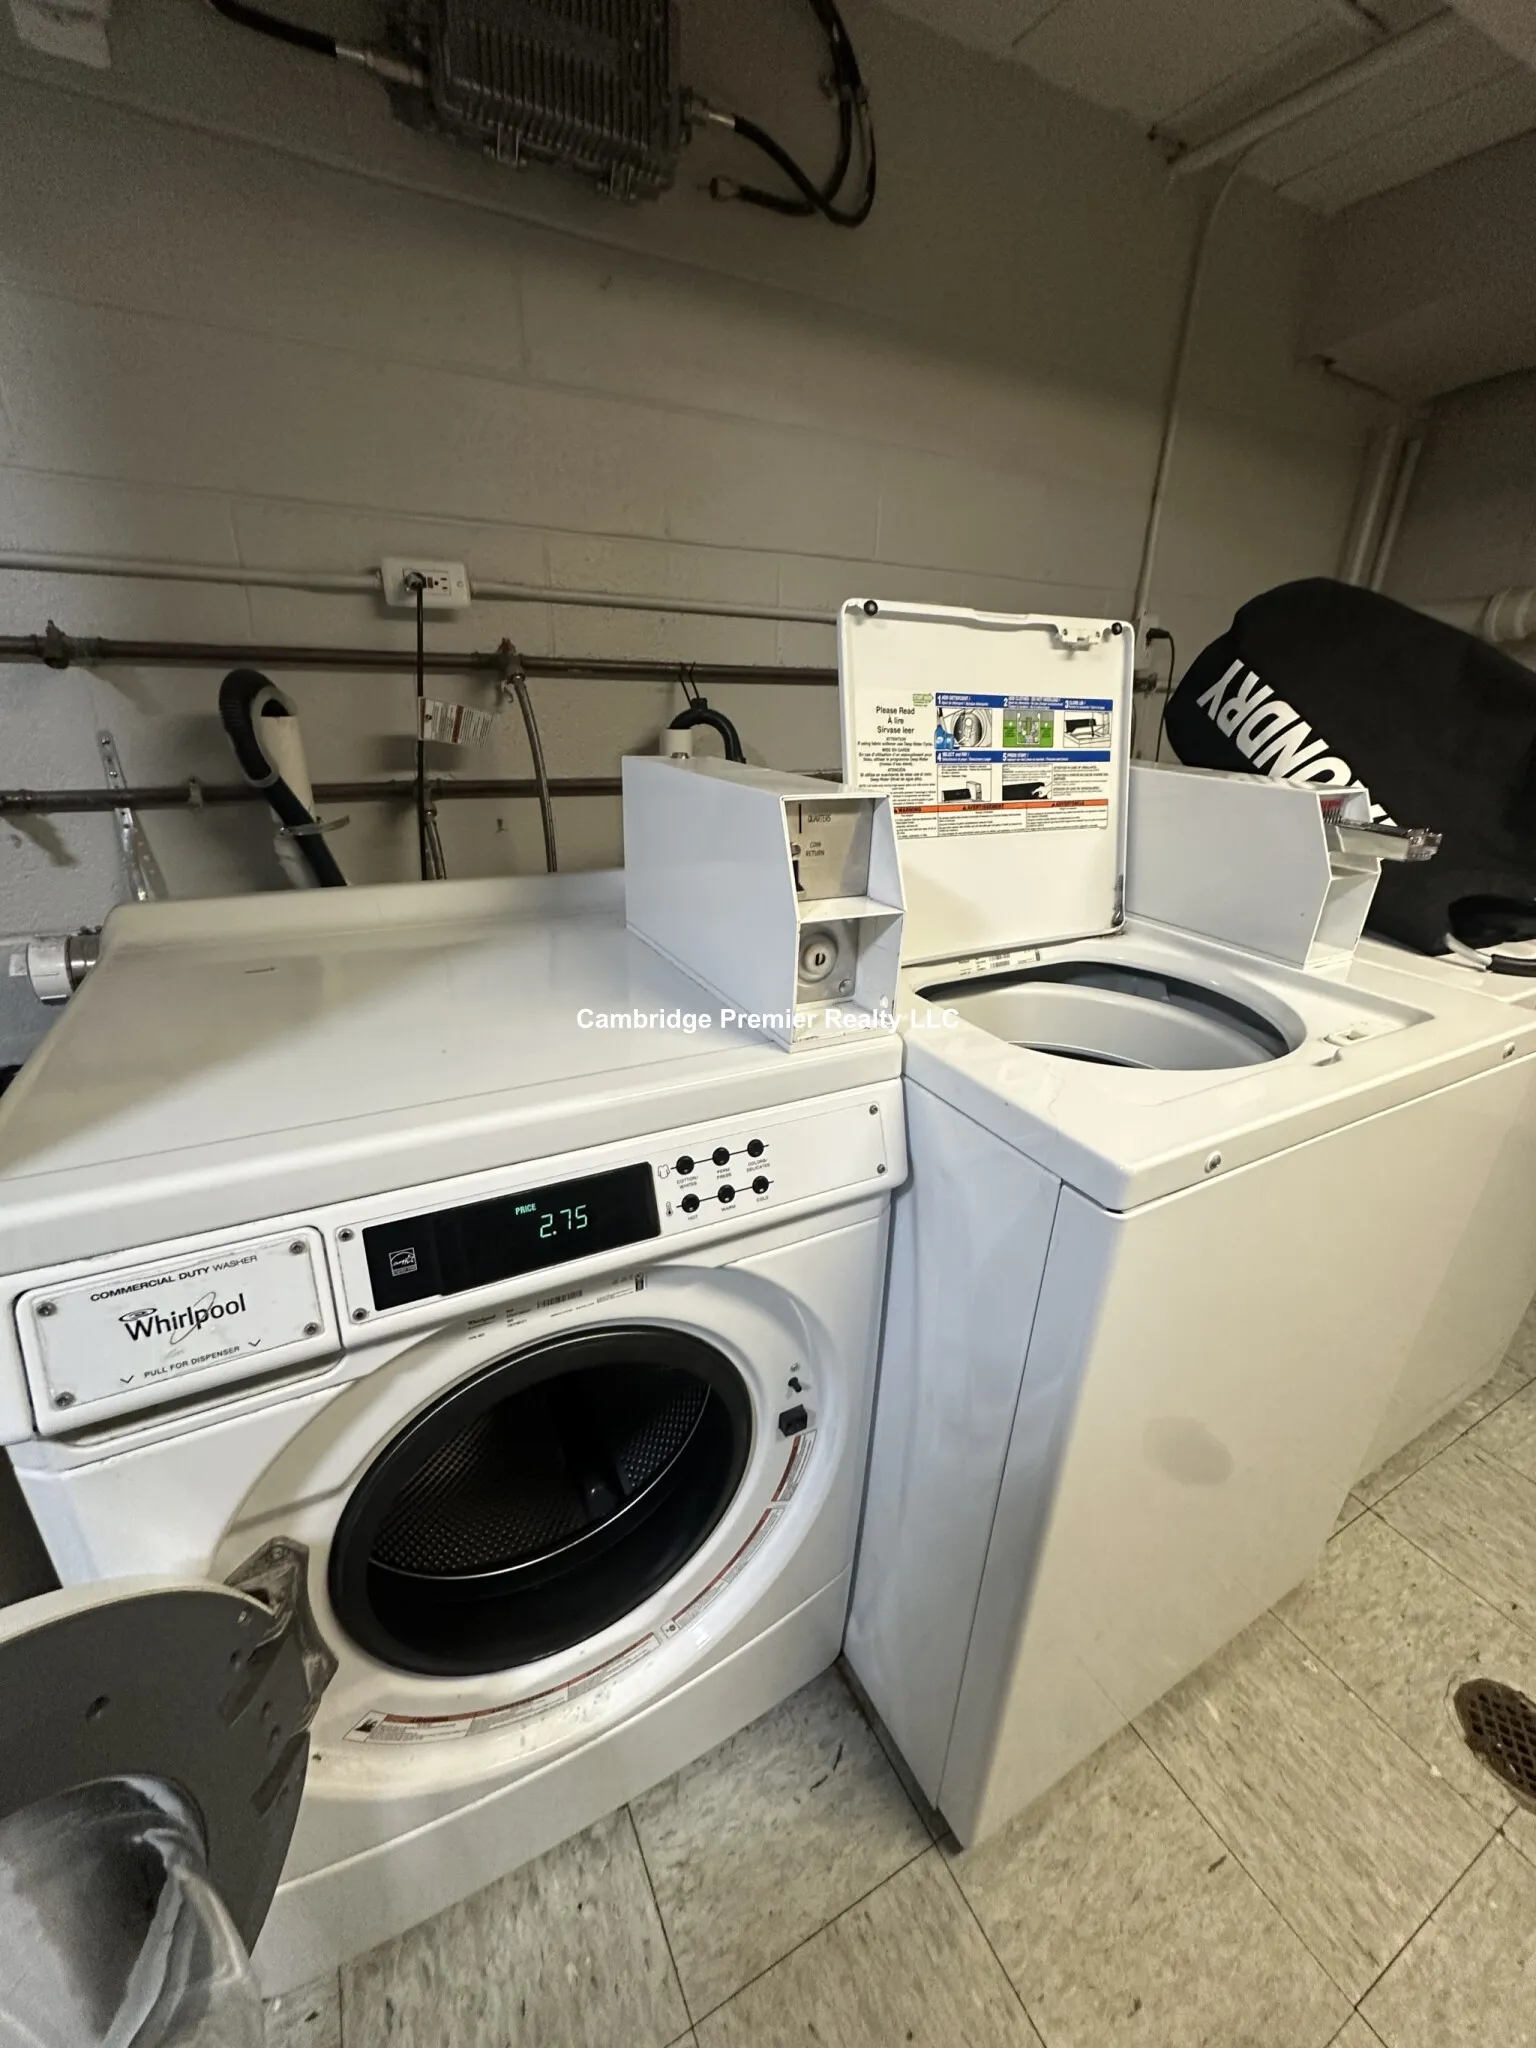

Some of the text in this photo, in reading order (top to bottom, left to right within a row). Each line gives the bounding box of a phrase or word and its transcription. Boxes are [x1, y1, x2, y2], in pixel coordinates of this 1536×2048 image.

[876, 706, 915, 715] Please Read
[515, 1203, 537, 1216] PRICE
[540, 1204, 588, 1239] 2.75
[90, 1255, 258, 1302] COMMERCIAL DUTY WASHER
[124, 1293, 246, 1341] Whirlpool
[144, 1346, 240, 1379] PULL FOR DISPENSER
